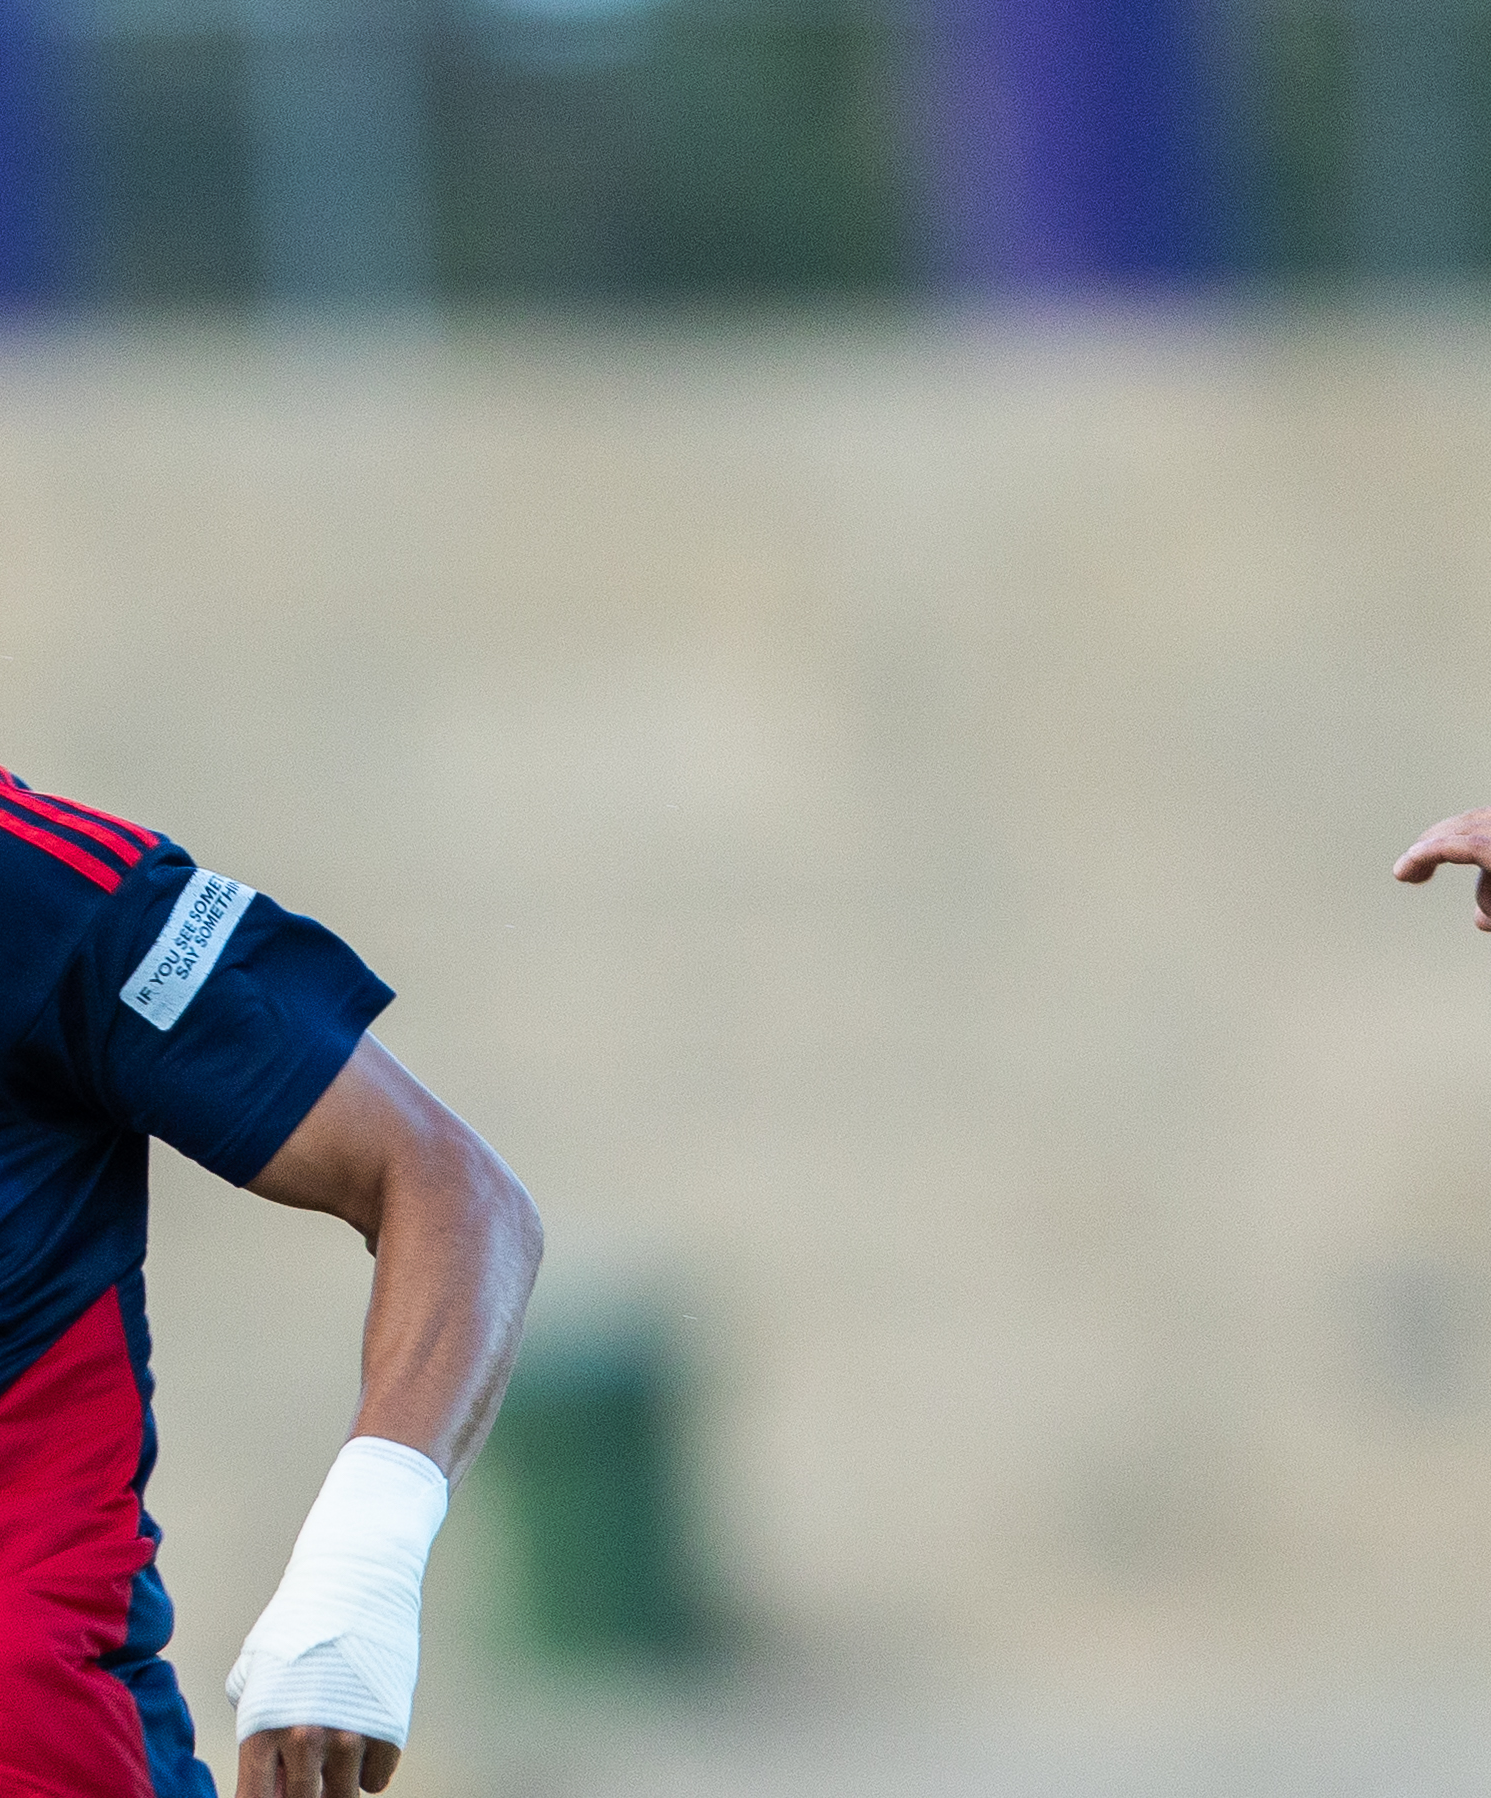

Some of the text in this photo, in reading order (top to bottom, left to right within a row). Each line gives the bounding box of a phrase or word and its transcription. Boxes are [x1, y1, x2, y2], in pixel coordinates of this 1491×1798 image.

[136, 986, 152, 1005] IF
[149, 949, 180, 985] YOU
[174, 920, 197, 950] SEE
[176, 946, 199, 980] SAY
